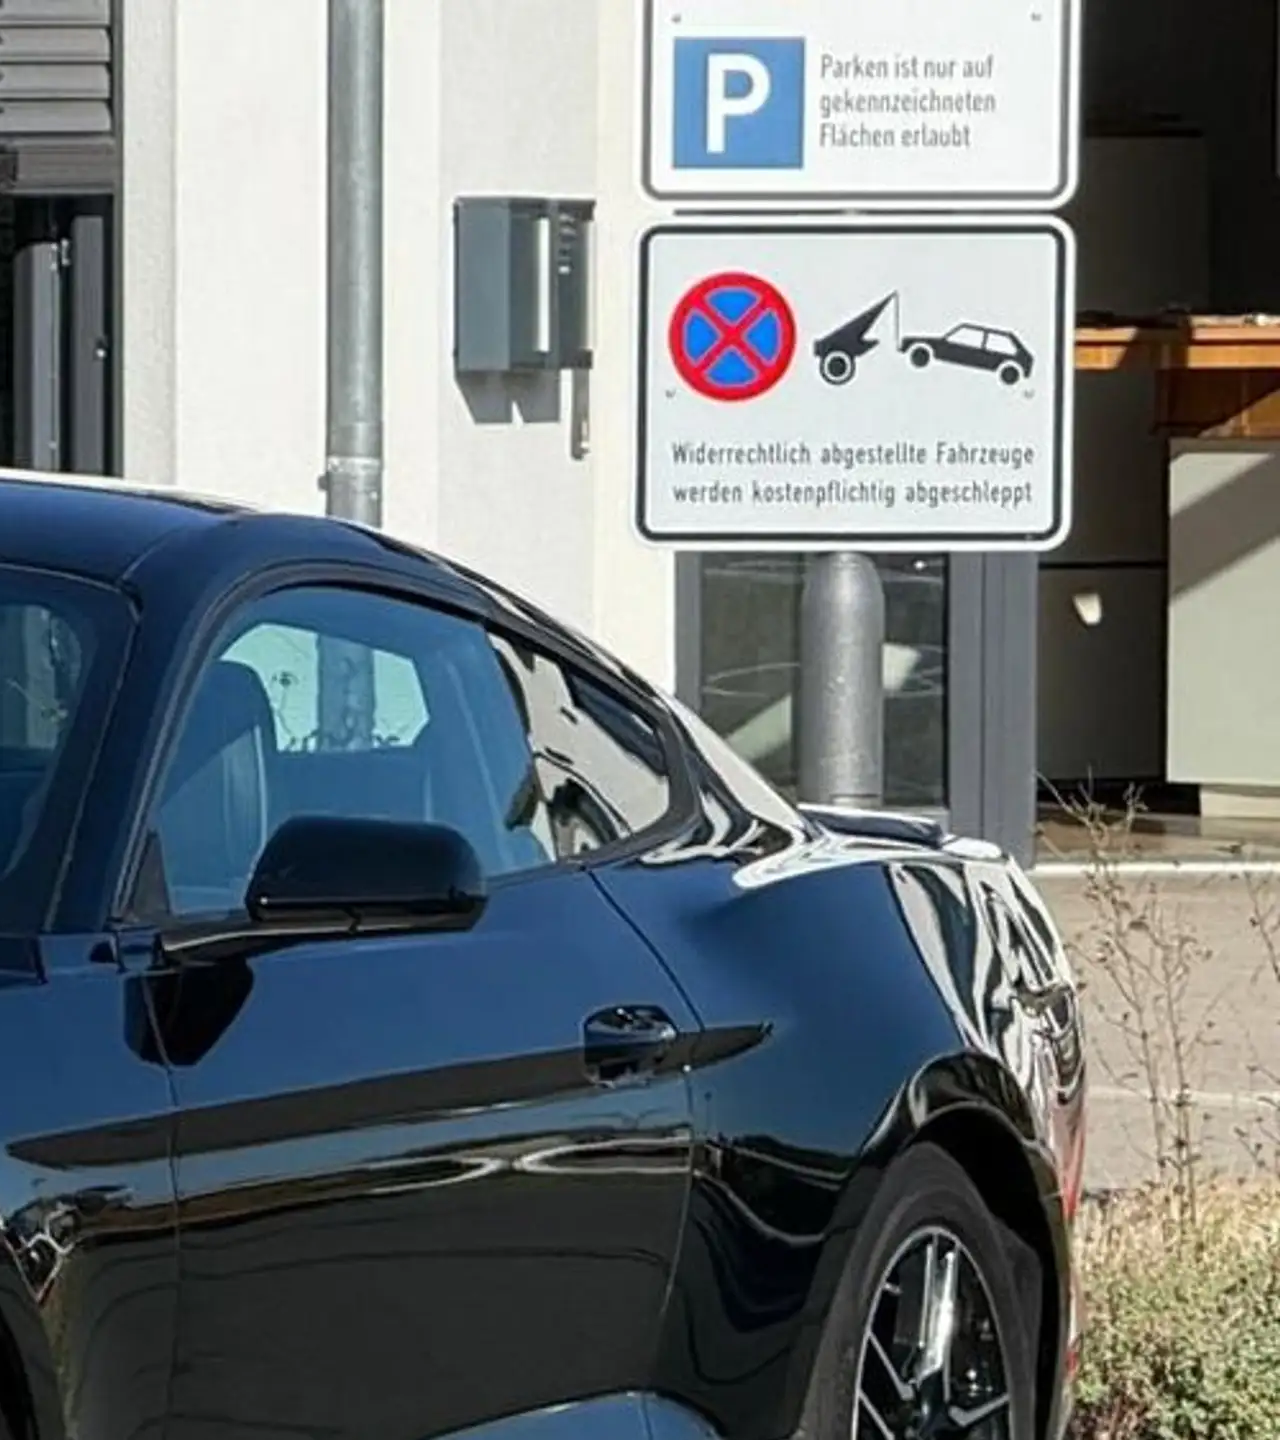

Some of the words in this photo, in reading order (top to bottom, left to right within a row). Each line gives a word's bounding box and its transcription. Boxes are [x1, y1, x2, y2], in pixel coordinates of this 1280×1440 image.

[822, 54, 887, 78] Parken
[895, 54, 918, 78] ist
[924, 61, 955, 77] nur
[962, 54, 994, 78] auf
[706, 53, 771, 153] P
[821, 90, 995, 118] gekennzeichneten
[820, 123, 894, 146] Flächen
[902, 124, 969, 146] erlaubt
[673, 443, 810, 464] Widerrechtlich
[821, 443, 925, 469] abgestellte
[937, 442, 1033, 469] Fahrzeuge
[674, 482, 741, 502] werden
[753, 481, 894, 508] kostenpflichtig
[906, 482, 1030, 508] abgeschleppt
